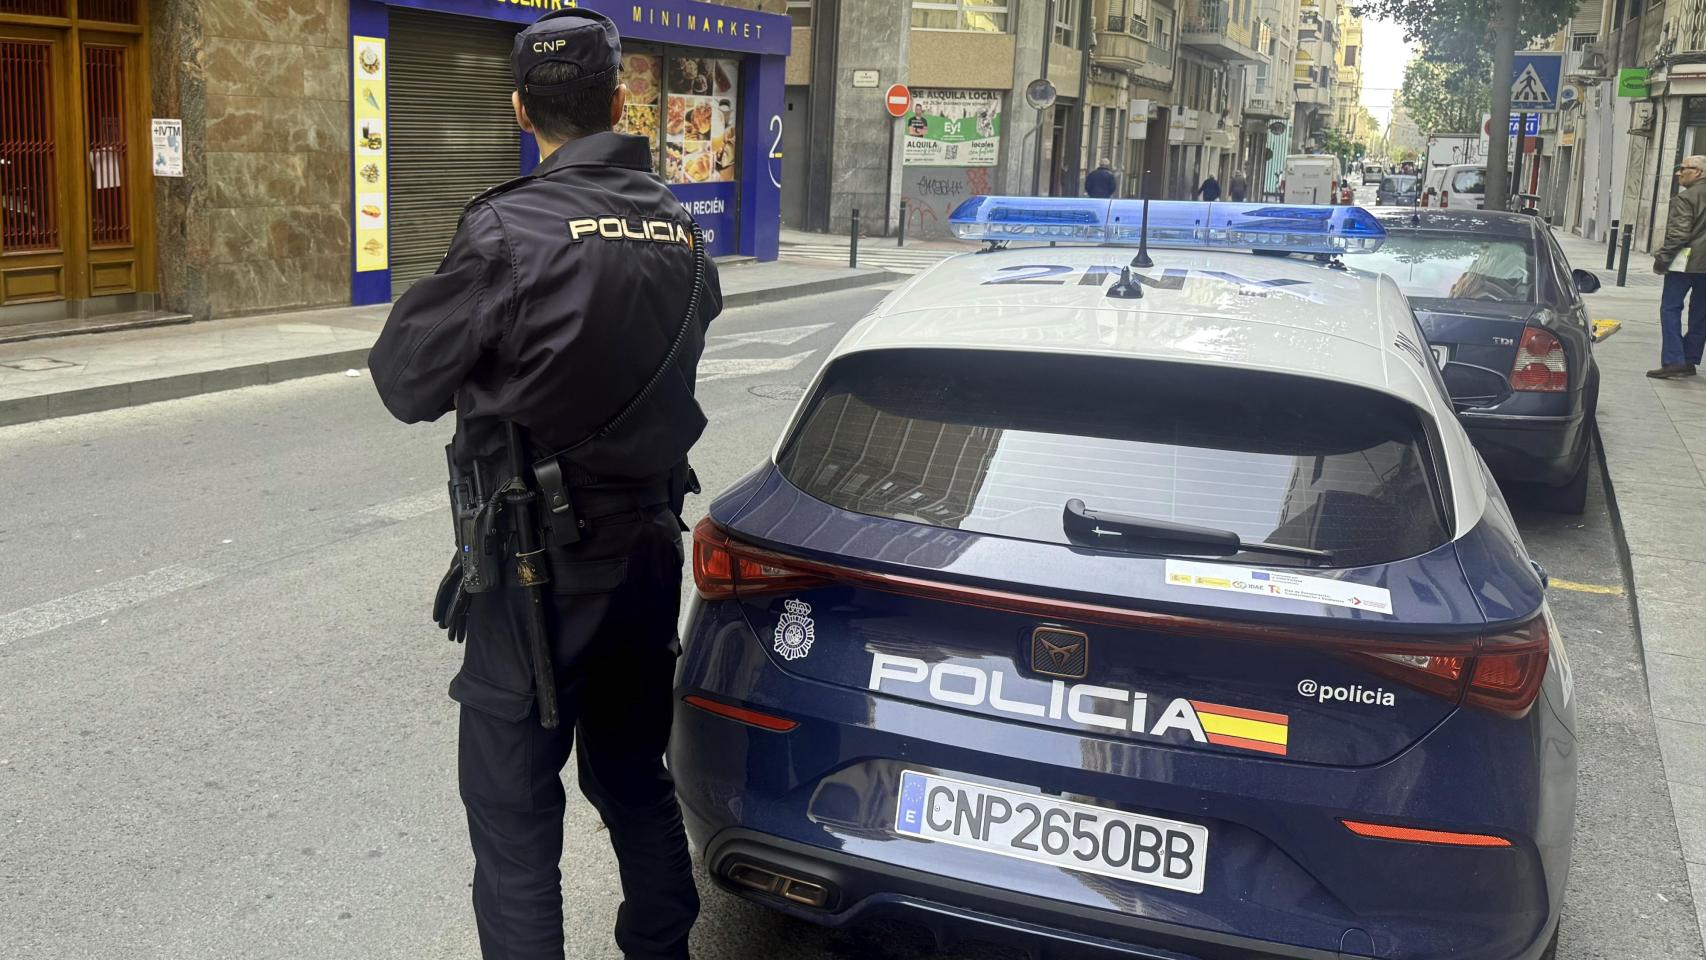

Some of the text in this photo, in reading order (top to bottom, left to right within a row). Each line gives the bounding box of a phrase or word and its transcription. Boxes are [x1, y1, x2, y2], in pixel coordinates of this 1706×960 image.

[632, 6, 763, 39] MINIMARKET
[533, 39, 567, 53] CNP
[912, 90, 998, 101] SE ALQUILA LOCAL
[944, 121, 961, 135] Ey!
[907, 141, 938, 149] ALQUILA
[693, 197, 725, 215] RECIÉN
[1492, 336, 1514, 346] TDI
[1297, 679, 1395, 706] @policia
[905, 810, 916, 823] E
[925, 785, 1195, 880] CNP2650BB
